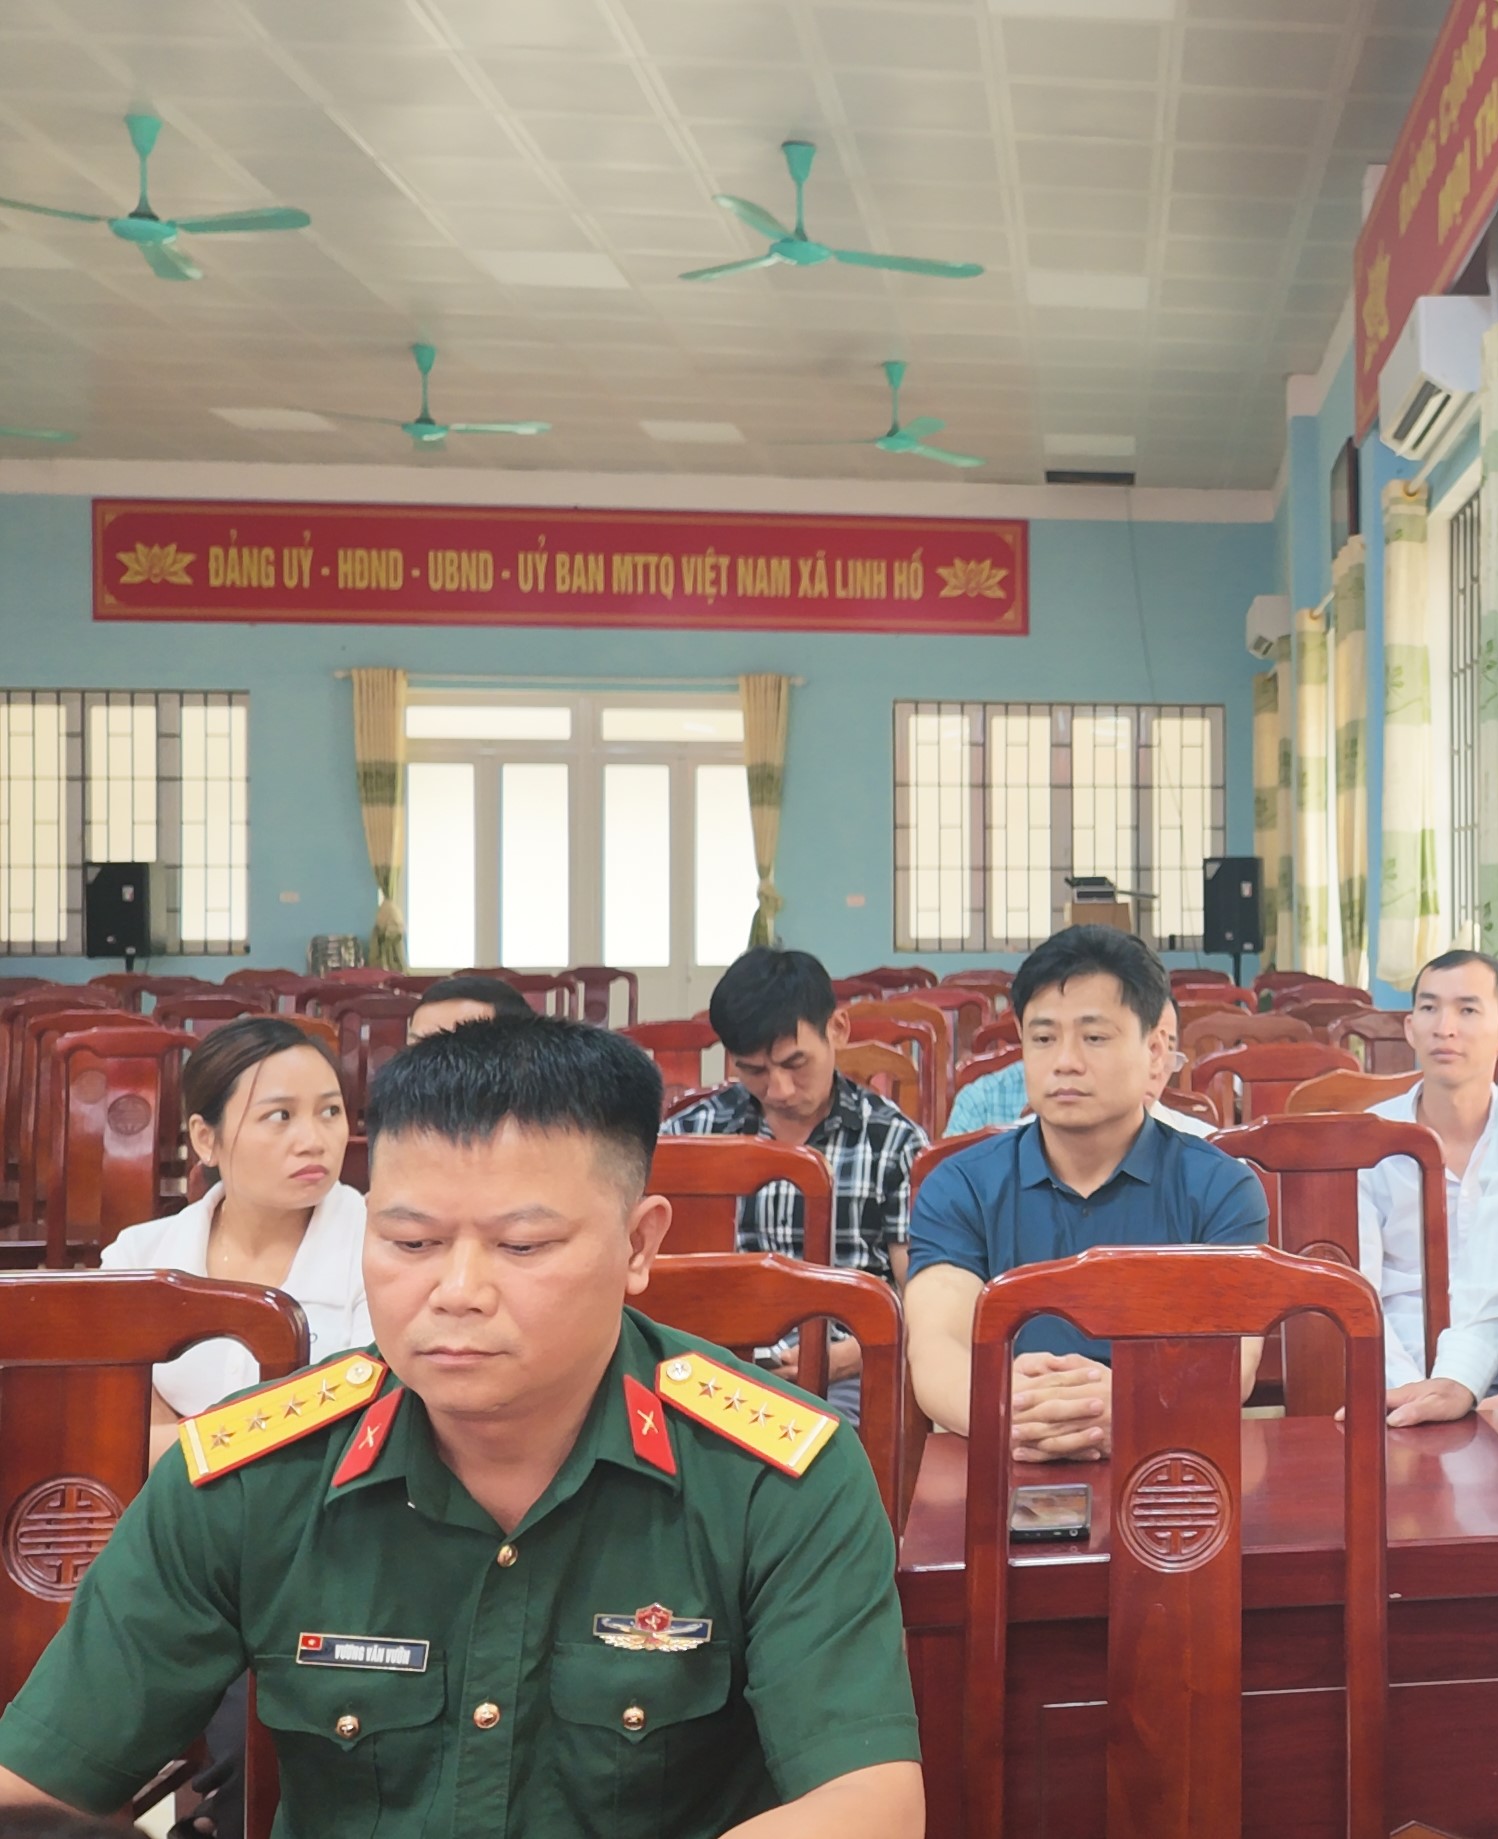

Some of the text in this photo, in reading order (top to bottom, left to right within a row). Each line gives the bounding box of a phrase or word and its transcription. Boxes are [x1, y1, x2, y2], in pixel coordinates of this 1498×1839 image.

[208, 528, 275, 588] ĐẢNG
[283, 529, 314, 589] UỶ
[337, 547, 404, 591] HĐND
[428, 549, 494, 592] UBND
[518, 533, 548, 593] UỶ
[555, 551, 605, 594] BAN
[612, 552, 675, 601] MTTQ
[681, 545, 731, 605] VIỆT
[737, 557, 791, 598] NAM
[797, 549, 829, 599] XÃ
[835, 558, 887, 599] LINH
[365, 1644, 385, 1663] VĂN
